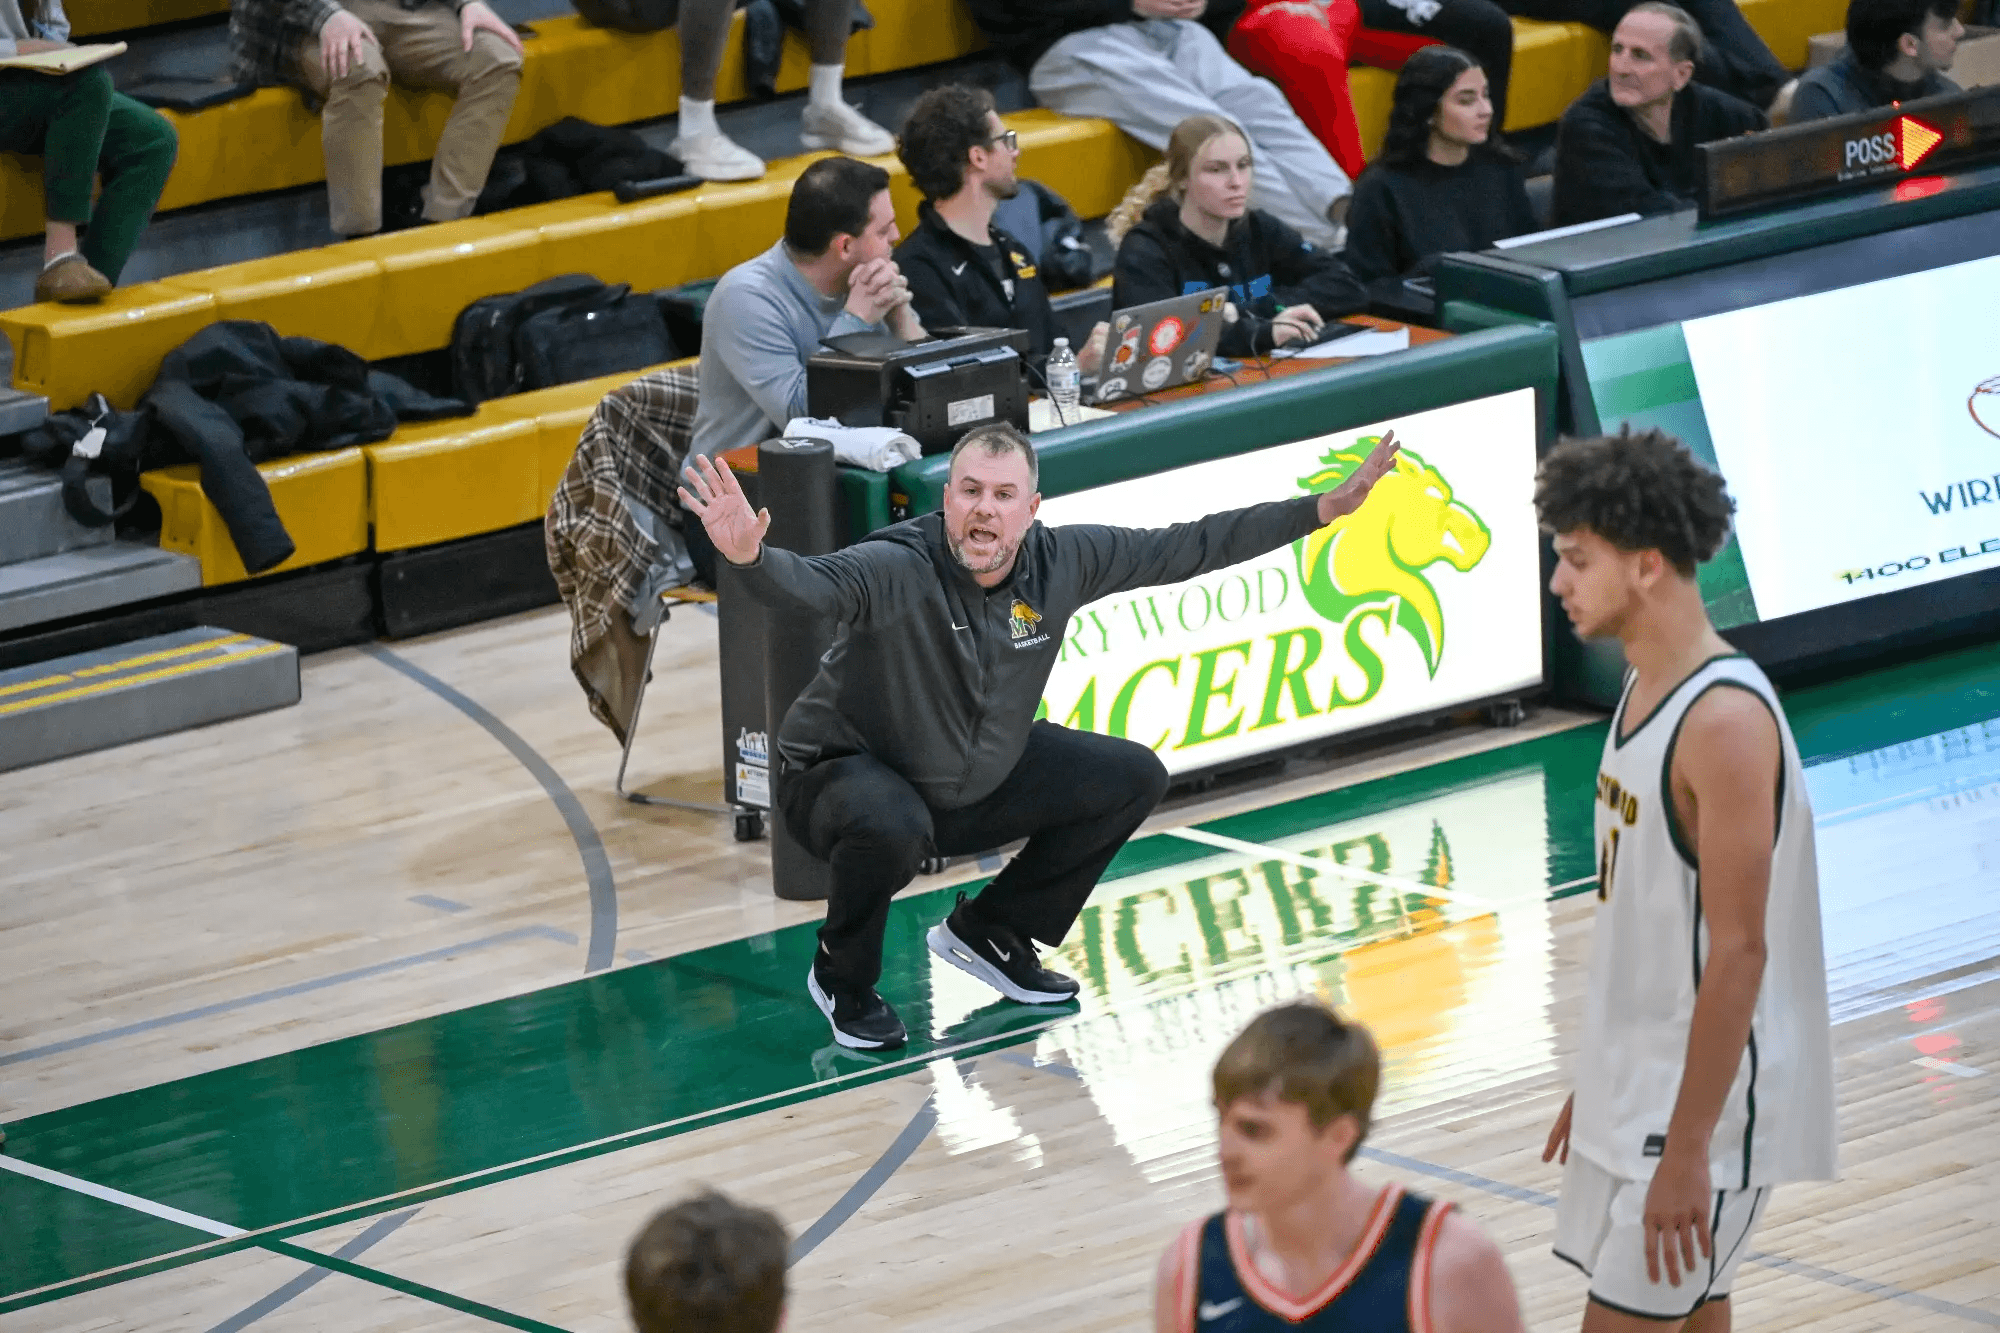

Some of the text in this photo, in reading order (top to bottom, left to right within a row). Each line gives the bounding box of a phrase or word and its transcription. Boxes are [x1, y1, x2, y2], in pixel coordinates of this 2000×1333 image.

[1845, 132, 1897, 168] POSS
[1014, 633, 1051, 650] BASKETBALL
[1033, 602, 1397, 751] ACERS
